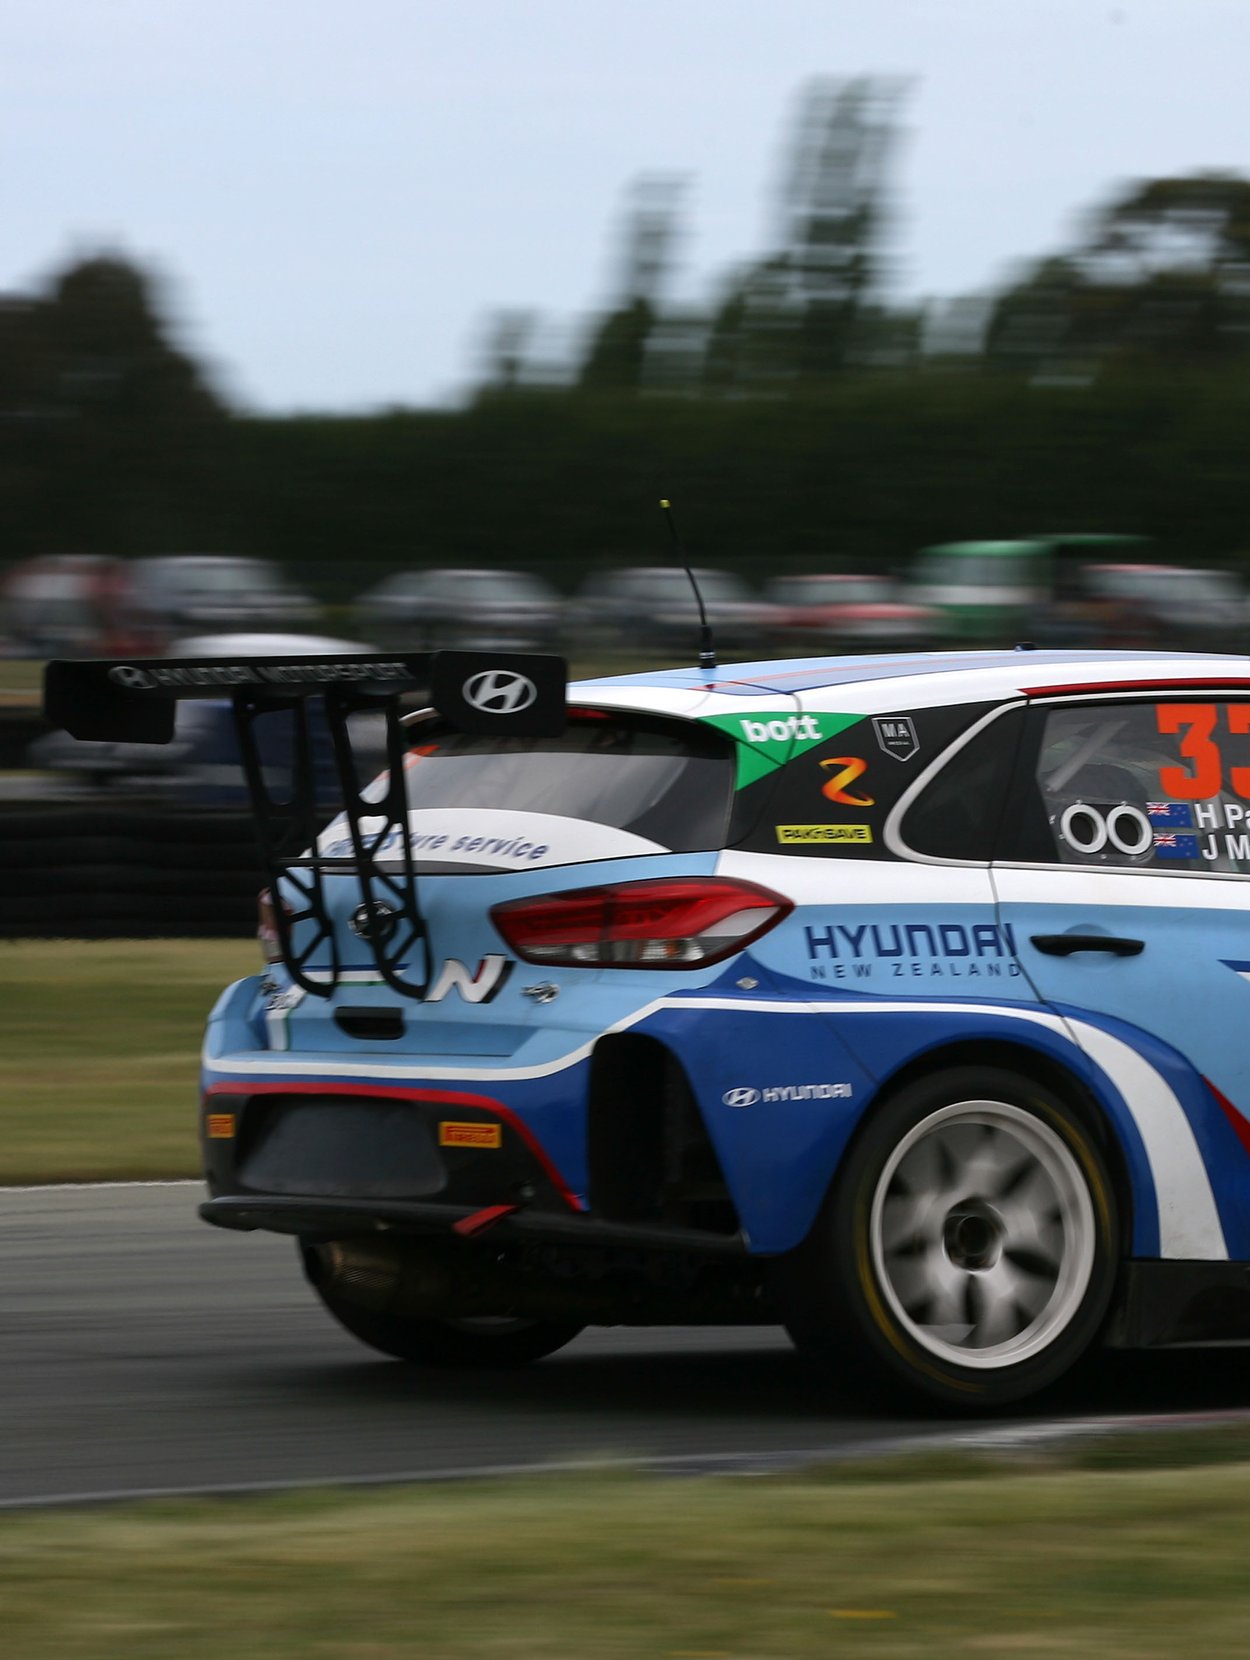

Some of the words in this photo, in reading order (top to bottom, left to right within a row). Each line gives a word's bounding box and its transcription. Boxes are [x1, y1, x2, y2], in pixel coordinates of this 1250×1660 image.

[740, 715, 823, 742] bott
[1194, 803, 1219, 829] H
[454, 834, 549, 860] service
[1202, 834, 1218, 860] J
[803, 923, 1018, 960] HYUNDAI
[810, 964, 873, 979] NEW
[891, 963, 1022, 977] ZEALAND
[762, 1083, 852, 1103] HYUNDAI
